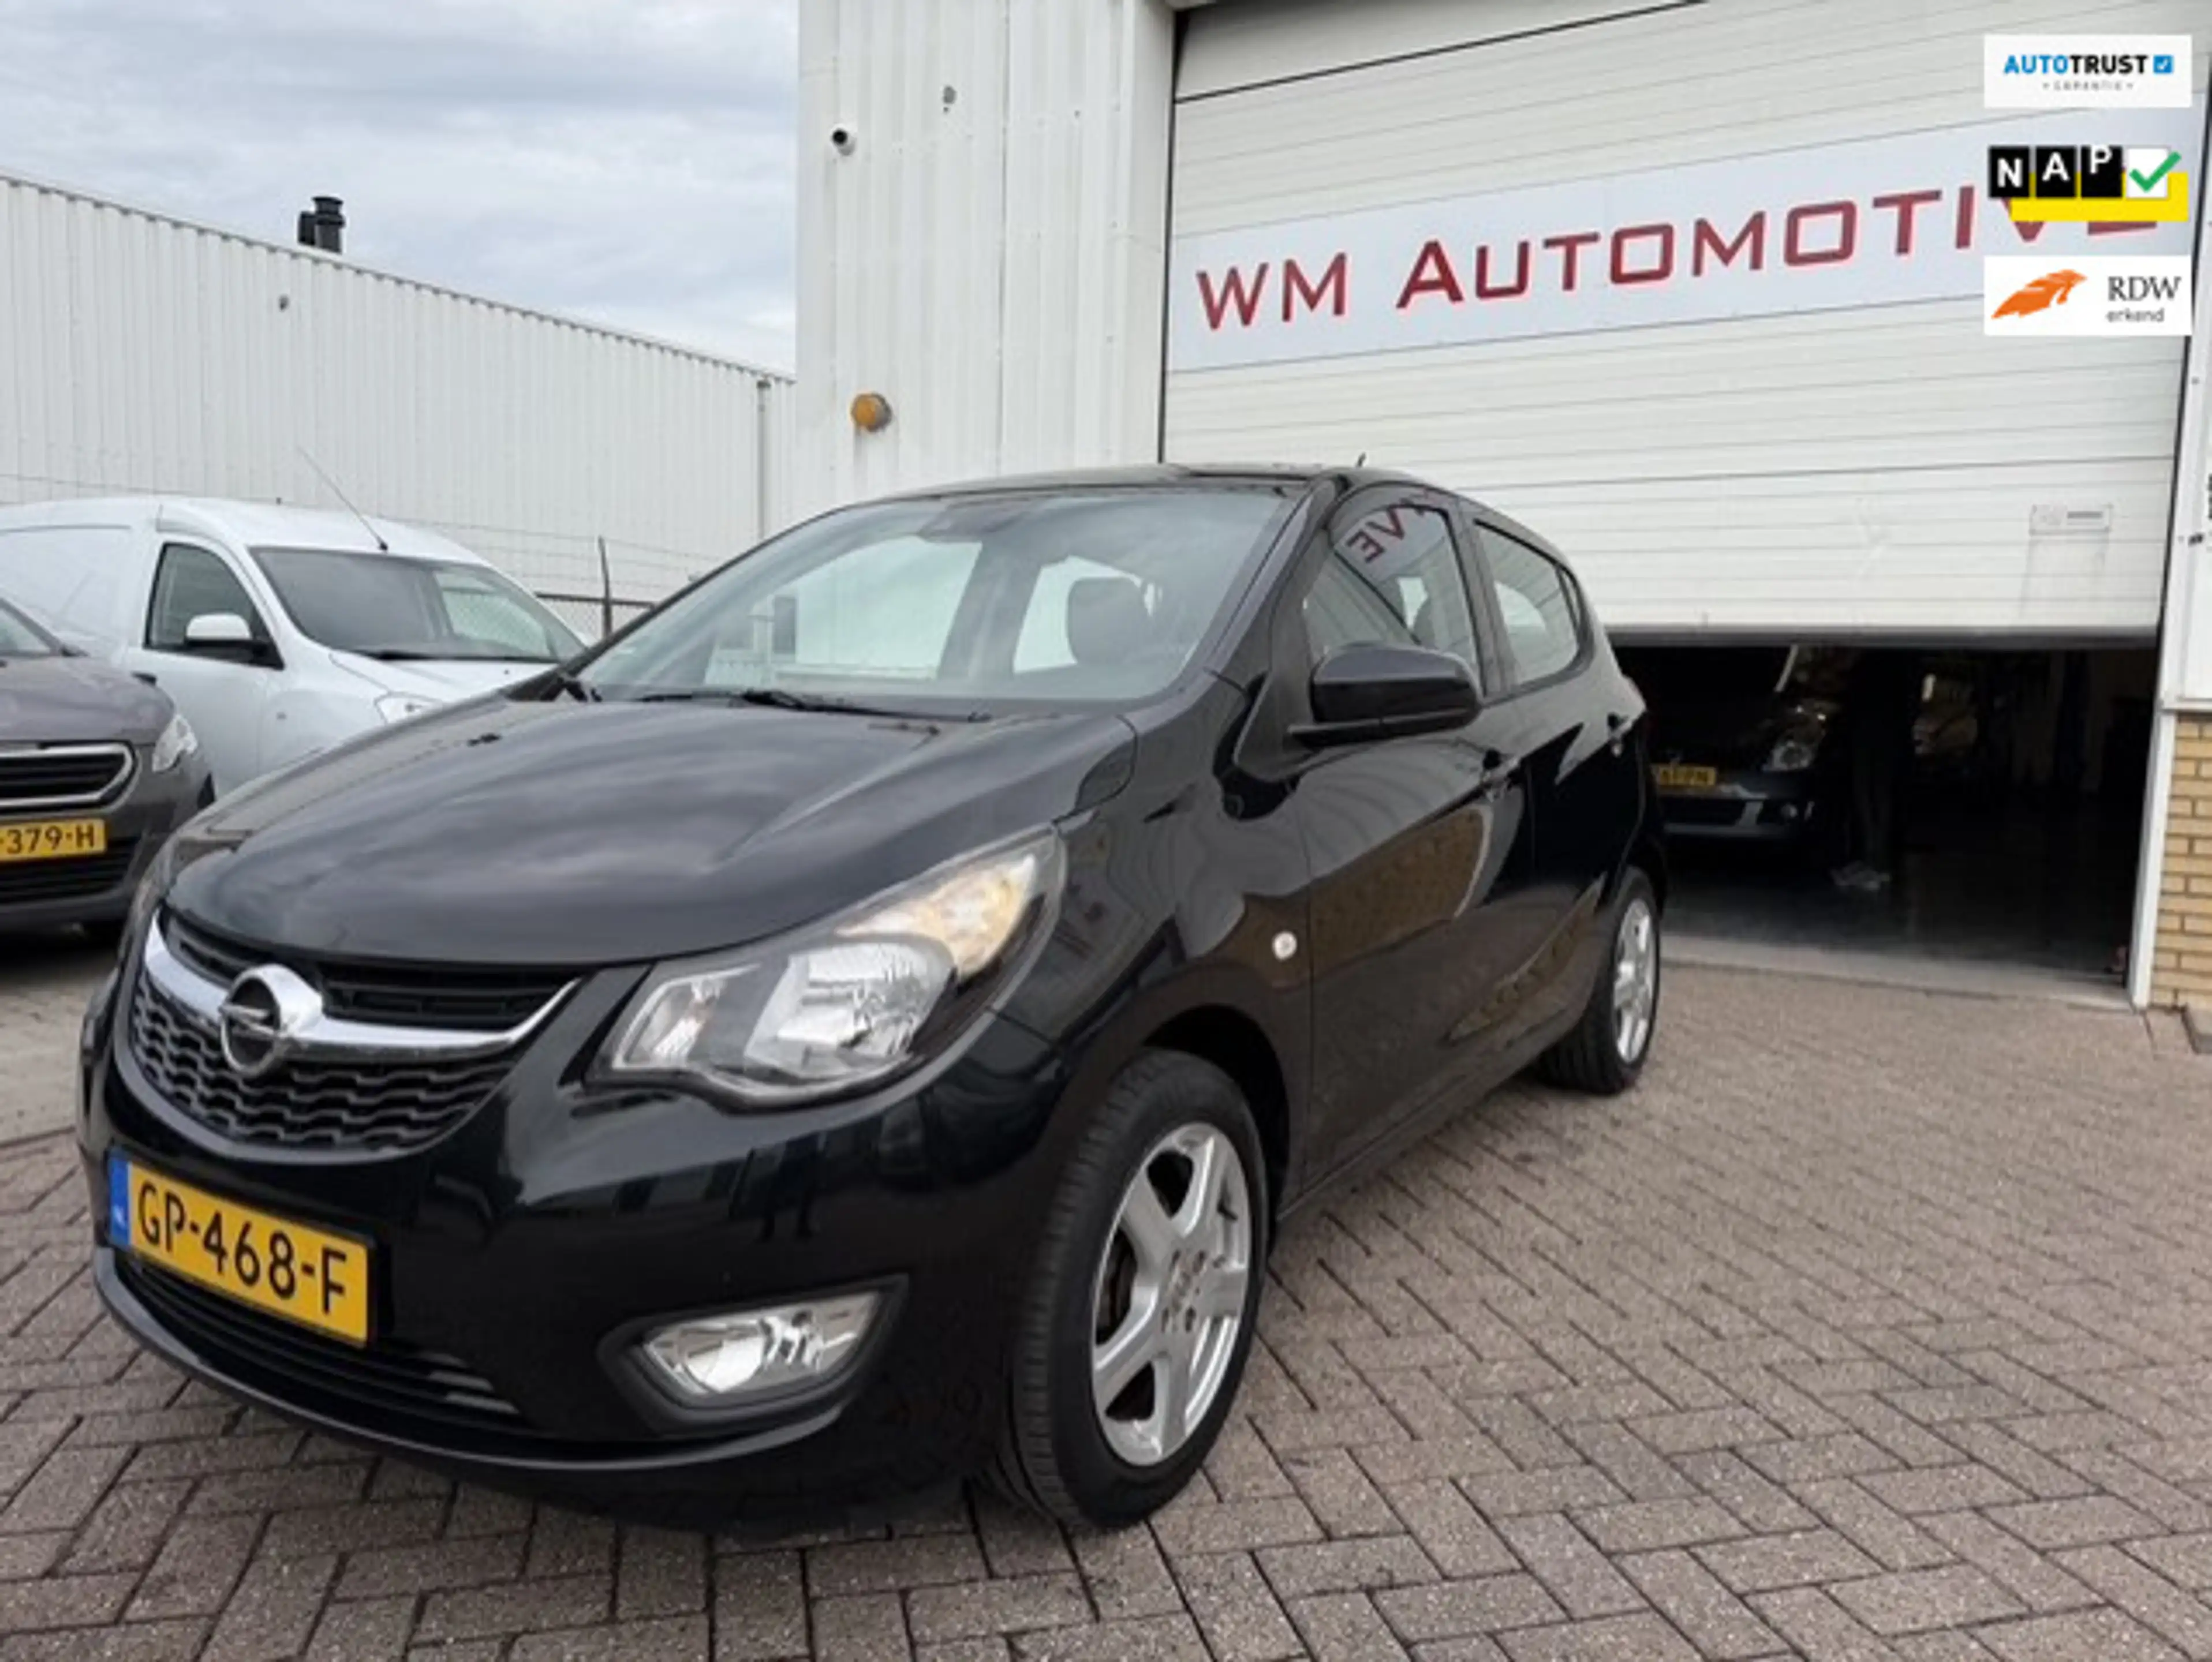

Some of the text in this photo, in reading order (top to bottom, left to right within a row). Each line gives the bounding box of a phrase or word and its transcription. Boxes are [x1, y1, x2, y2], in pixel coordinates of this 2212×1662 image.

[1196, 185, 2157, 330] WM AUTOMOTI
[137, 1180, 348, 1315] GP-468-F
